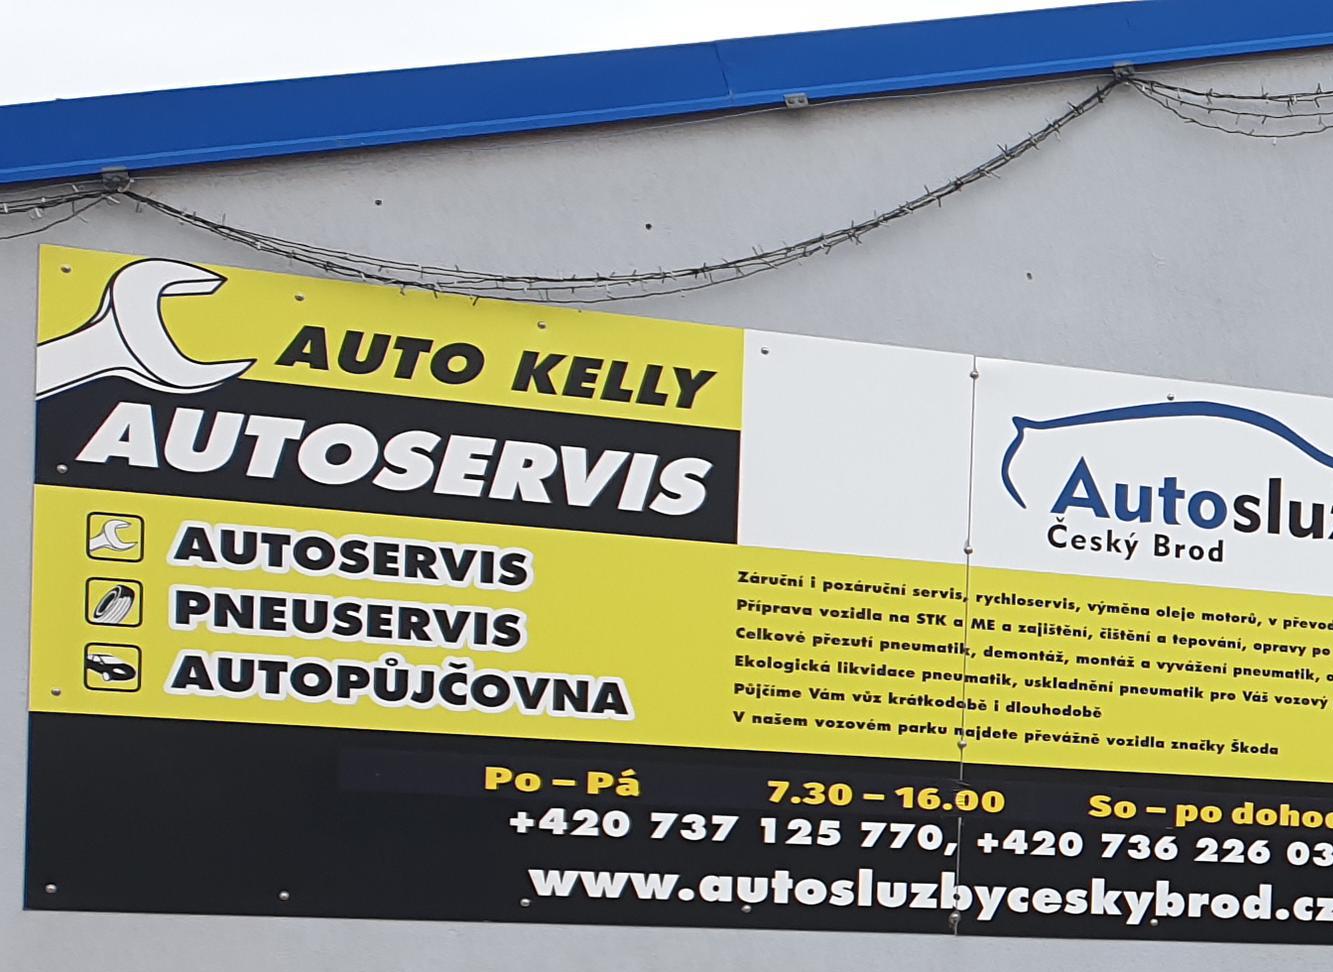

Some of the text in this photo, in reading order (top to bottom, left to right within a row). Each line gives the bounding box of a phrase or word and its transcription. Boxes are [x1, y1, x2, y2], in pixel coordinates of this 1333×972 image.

[275, 325, 719, 410] AUTO KELLY
[76, 401, 714, 516] AUTOSERVIS
[173, 527, 528, 587] AUTOSERVIS
[1047, 518, 1224, 562] Český Brod
[174, 590, 523, 647] PNEUSERVIS
[737, 570, 804, 588] Záruční
[810, 575, 816, 589] i
[822, 579, 906, 596] pozáruční
[975, 592, 1081, 613] rychloservis,
[1087, 600, 1150, 616] výměna
[1155, 605, 1196, 622] oleje
[1201, 612, 1262, 627] motorů,
[1268, 617, 1278, 626] v
[735, 627, 806, 644] Celkové
[812, 633, 873, 648] přezutí
[879, 640, 977, 659] pneumatik,
[983, 645, 1070, 665] demontáž,
[1075, 655, 1135, 668] montáž
[1140, 660, 1151, 669] a
[1156, 660, 1227, 675] vyvážení
[1233, 667, 1320, 683] pneumatik,
[736, 598, 813, 616] Příprava
[819, 606, 883, 622] vozidla
[889, 613, 910, 624] na
[916, 612, 947, 627] STK
[953, 618, 964, 628] a
[970, 617, 996, 631] ME
[1001, 623, 1012, 632] a
[1018, 622, 1093, 641] zajištění,
[1099, 627, 1151, 643] čištění
[1156, 635, 1167, 644] a
[1172, 634, 1247, 652] tepování,
[1253, 642, 1307, 657] opravy
[1312, 647, 1331, 658] po
[170, 656, 629, 716] AUTOPŮJČOVNA
[733, 682, 1102, 719] Půjčíme Vám vůz krátkodobě i dlouhodobě
[734, 654, 831, 674] Ekologická
[837, 661, 916, 679] likvidace
[921, 670, 1018, 689] pneumatik,
[1024, 676, 1114, 693] uskladnění
[1119, 685, 1204, 699] pneumatik
[1210, 691, 1236, 703] pro
[1242, 690, 1269, 703] Váš
[1274, 695, 1329, 710] vozový
[732, 710, 1279, 755] V našem vozovém parku najdete převážně vozidla značky Škoda
[484, 766, 542, 792] Po
[586, 768, 641, 798] Pá
[767, 780, 853, 807] 7.30
[894, 787, 1005, 813] 16.00
[1088, 795, 1138, 819] So
[1175, 803, 1222, 827] po
[509, 807, 631, 838] +420
[649, 812, 740, 842] 737
[760, 817, 841, 847] 125
[860, 821, 958, 857] 770,
[976, 829, 1083, 857] +420
[1101, 833, 1178, 861] 736
[1193, 838, 1271, 865] 226
